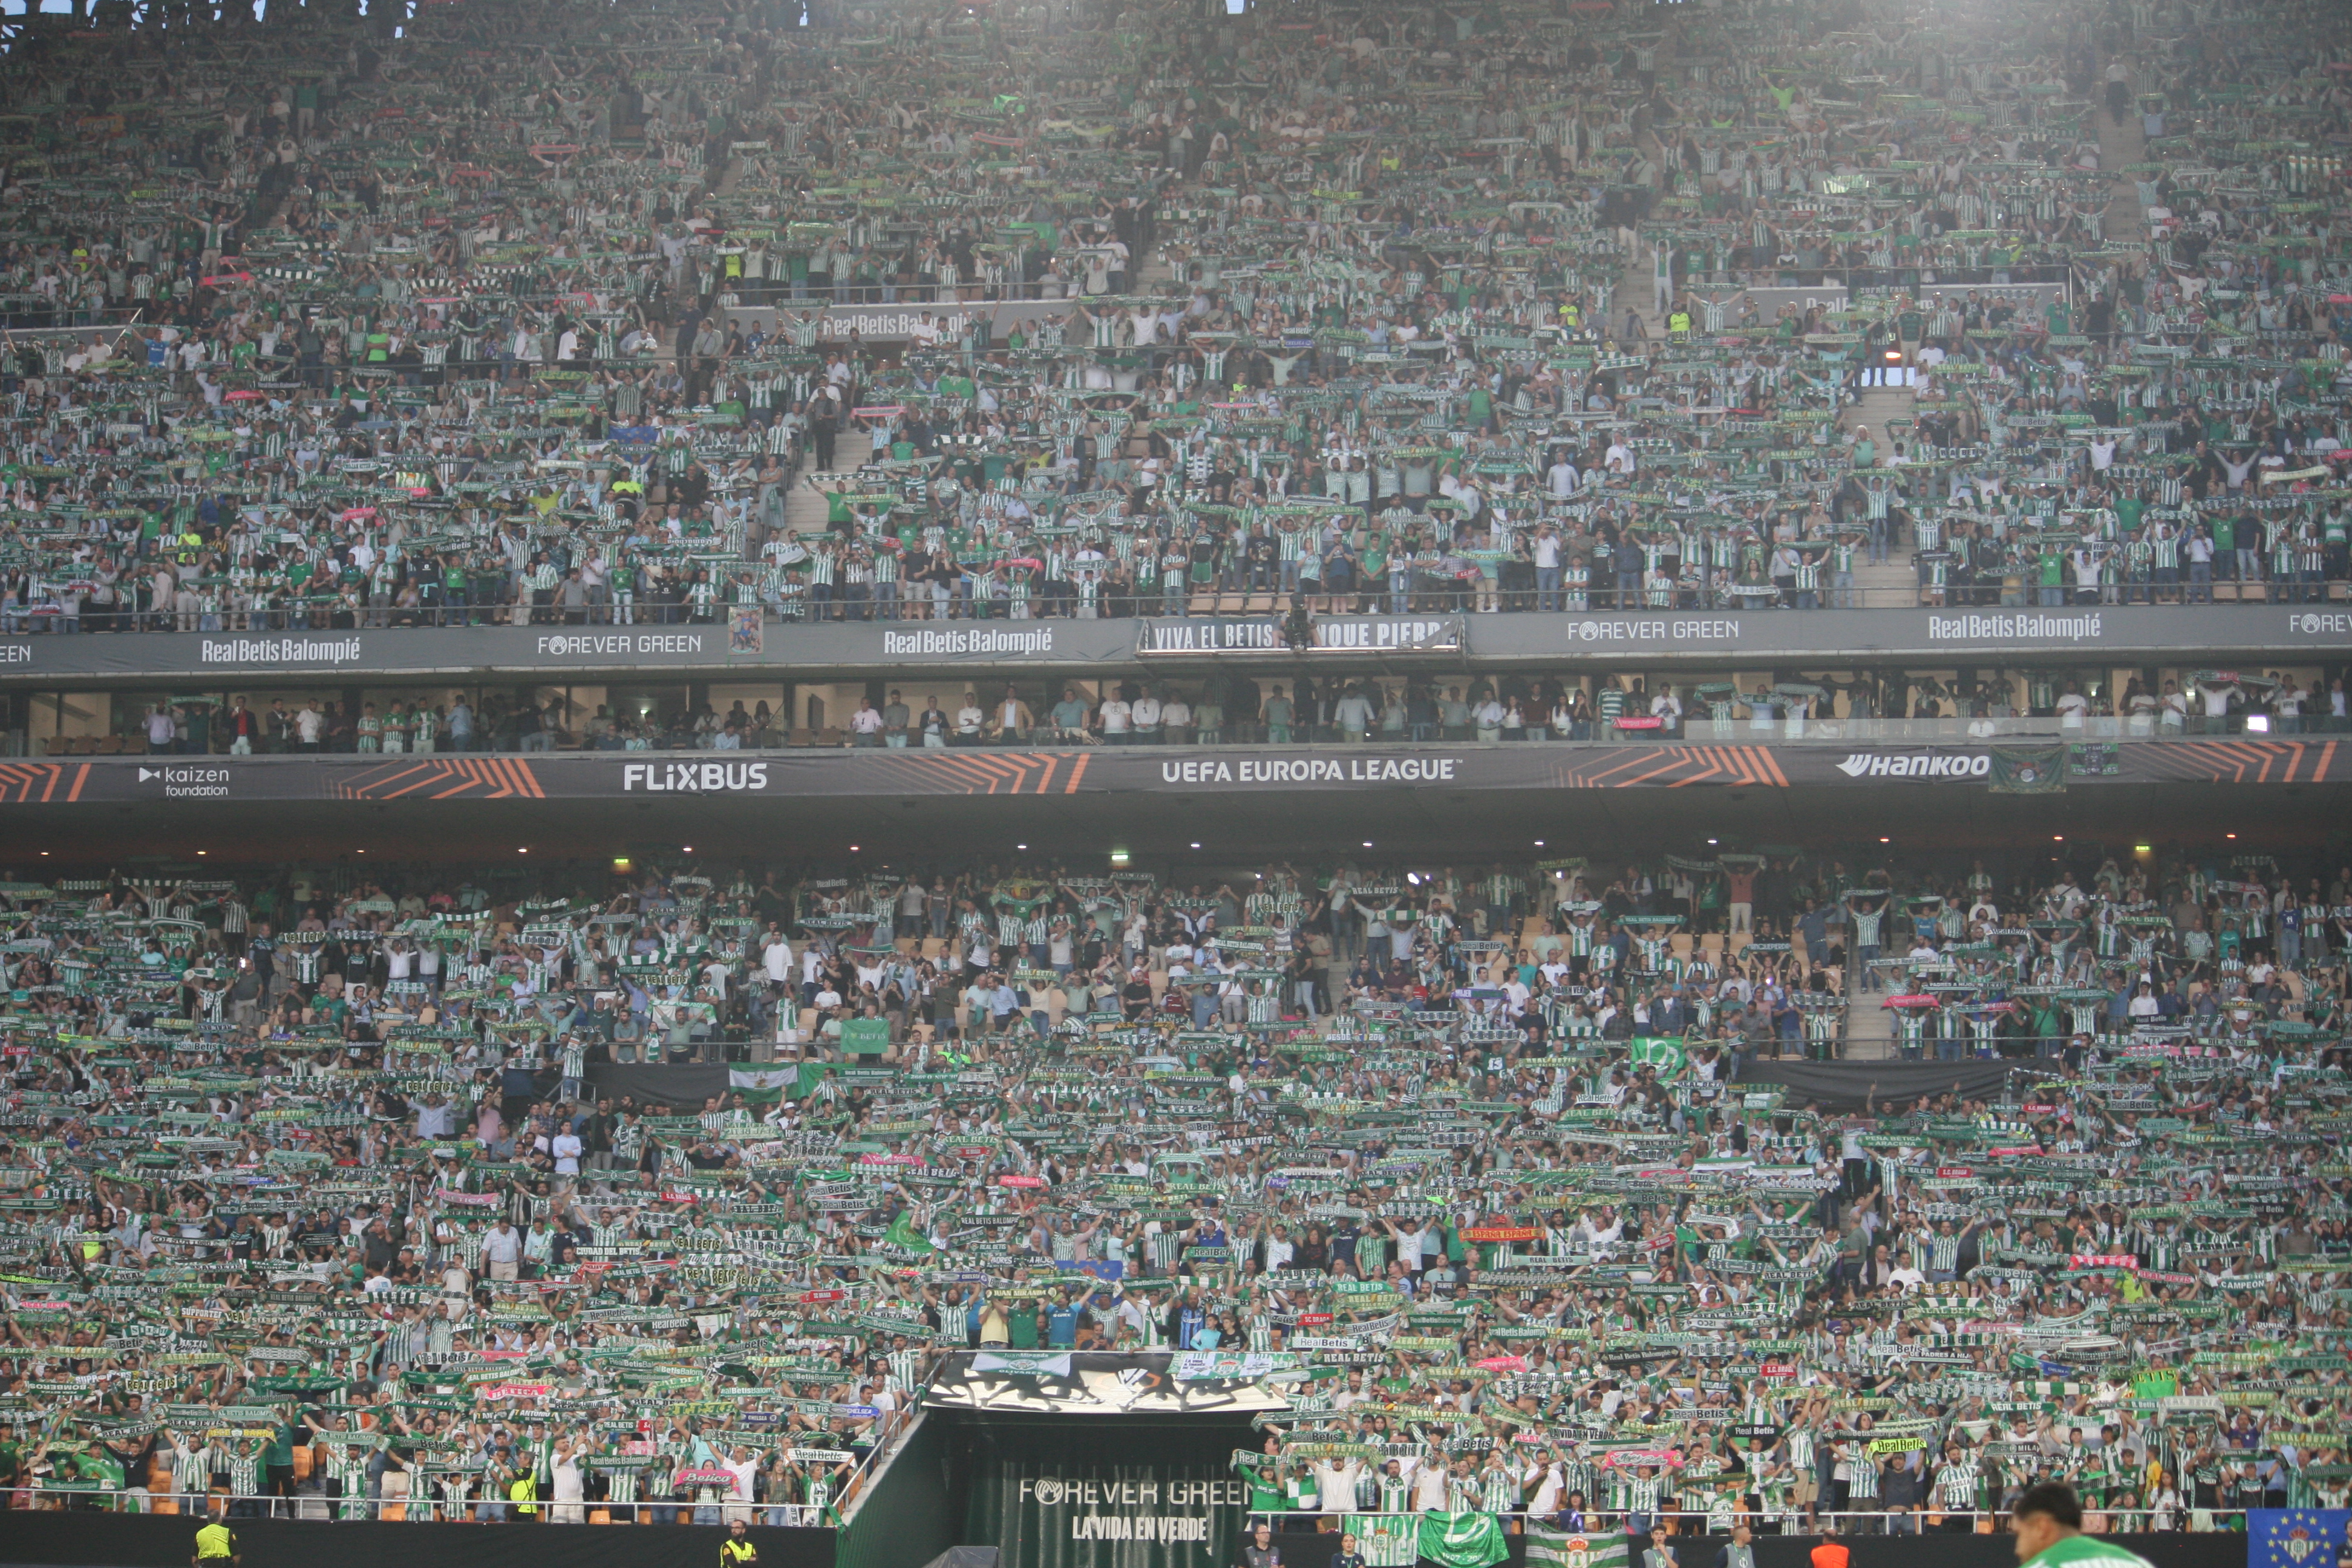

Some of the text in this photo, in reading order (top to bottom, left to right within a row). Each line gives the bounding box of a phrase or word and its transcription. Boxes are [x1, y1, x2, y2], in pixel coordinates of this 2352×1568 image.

[2290, 613, 2352, 633] FORE
[1673, 620, 1738, 638] GREEN
[1155, 627, 1194, 649] VIVA
[1201, 627, 1218, 648] EL
[1226, 624, 1272, 647] BETIS
[1377, 621, 1455, 646] PIERD
[638, 635, 701, 653] GREEN
[165, 767, 229, 783] kaizen
[1163, 759, 1454, 782] UEFA EUROPA LEAGUE
[166, 785, 228, 796] foundation
[1352, 887, 1399, 895] REAL BETIS
[286, 932, 325, 942] REAL BETIS
[646, 975, 688, 984] REAL BETIS
[2135, 1014, 2167, 1024] Real Betis
[408, 1082, 450, 1091] REAL BETIS
[1220, 1135, 1273, 1147] REAL BETIS
[674, 1238, 720, 1249] REAL BETIS
[1338, 1282, 1383, 1292] REAL BETIS
[994, 1289, 1047, 1298] JUAN MIRANDA
[1854, 1301, 1877, 1309] REAL
[646, 1345, 705, 1356] REAL BETIS
[1324, 1353, 1383, 1363] REAL BETIS
[127, 1378, 175, 1389] REAL BETIS
[2269, 1379, 2298, 1388] BETIS
[806, 1405, 828, 1413] BETIS
[2017, 1402, 2042, 1411] BETIS
[1549, 1428, 1612, 1440] LA VIDA EN VERDE
[1735, 1426, 1775, 1435] Real Betis
[1073, 1517, 1206, 1540] LA VIDA EN VERDE
